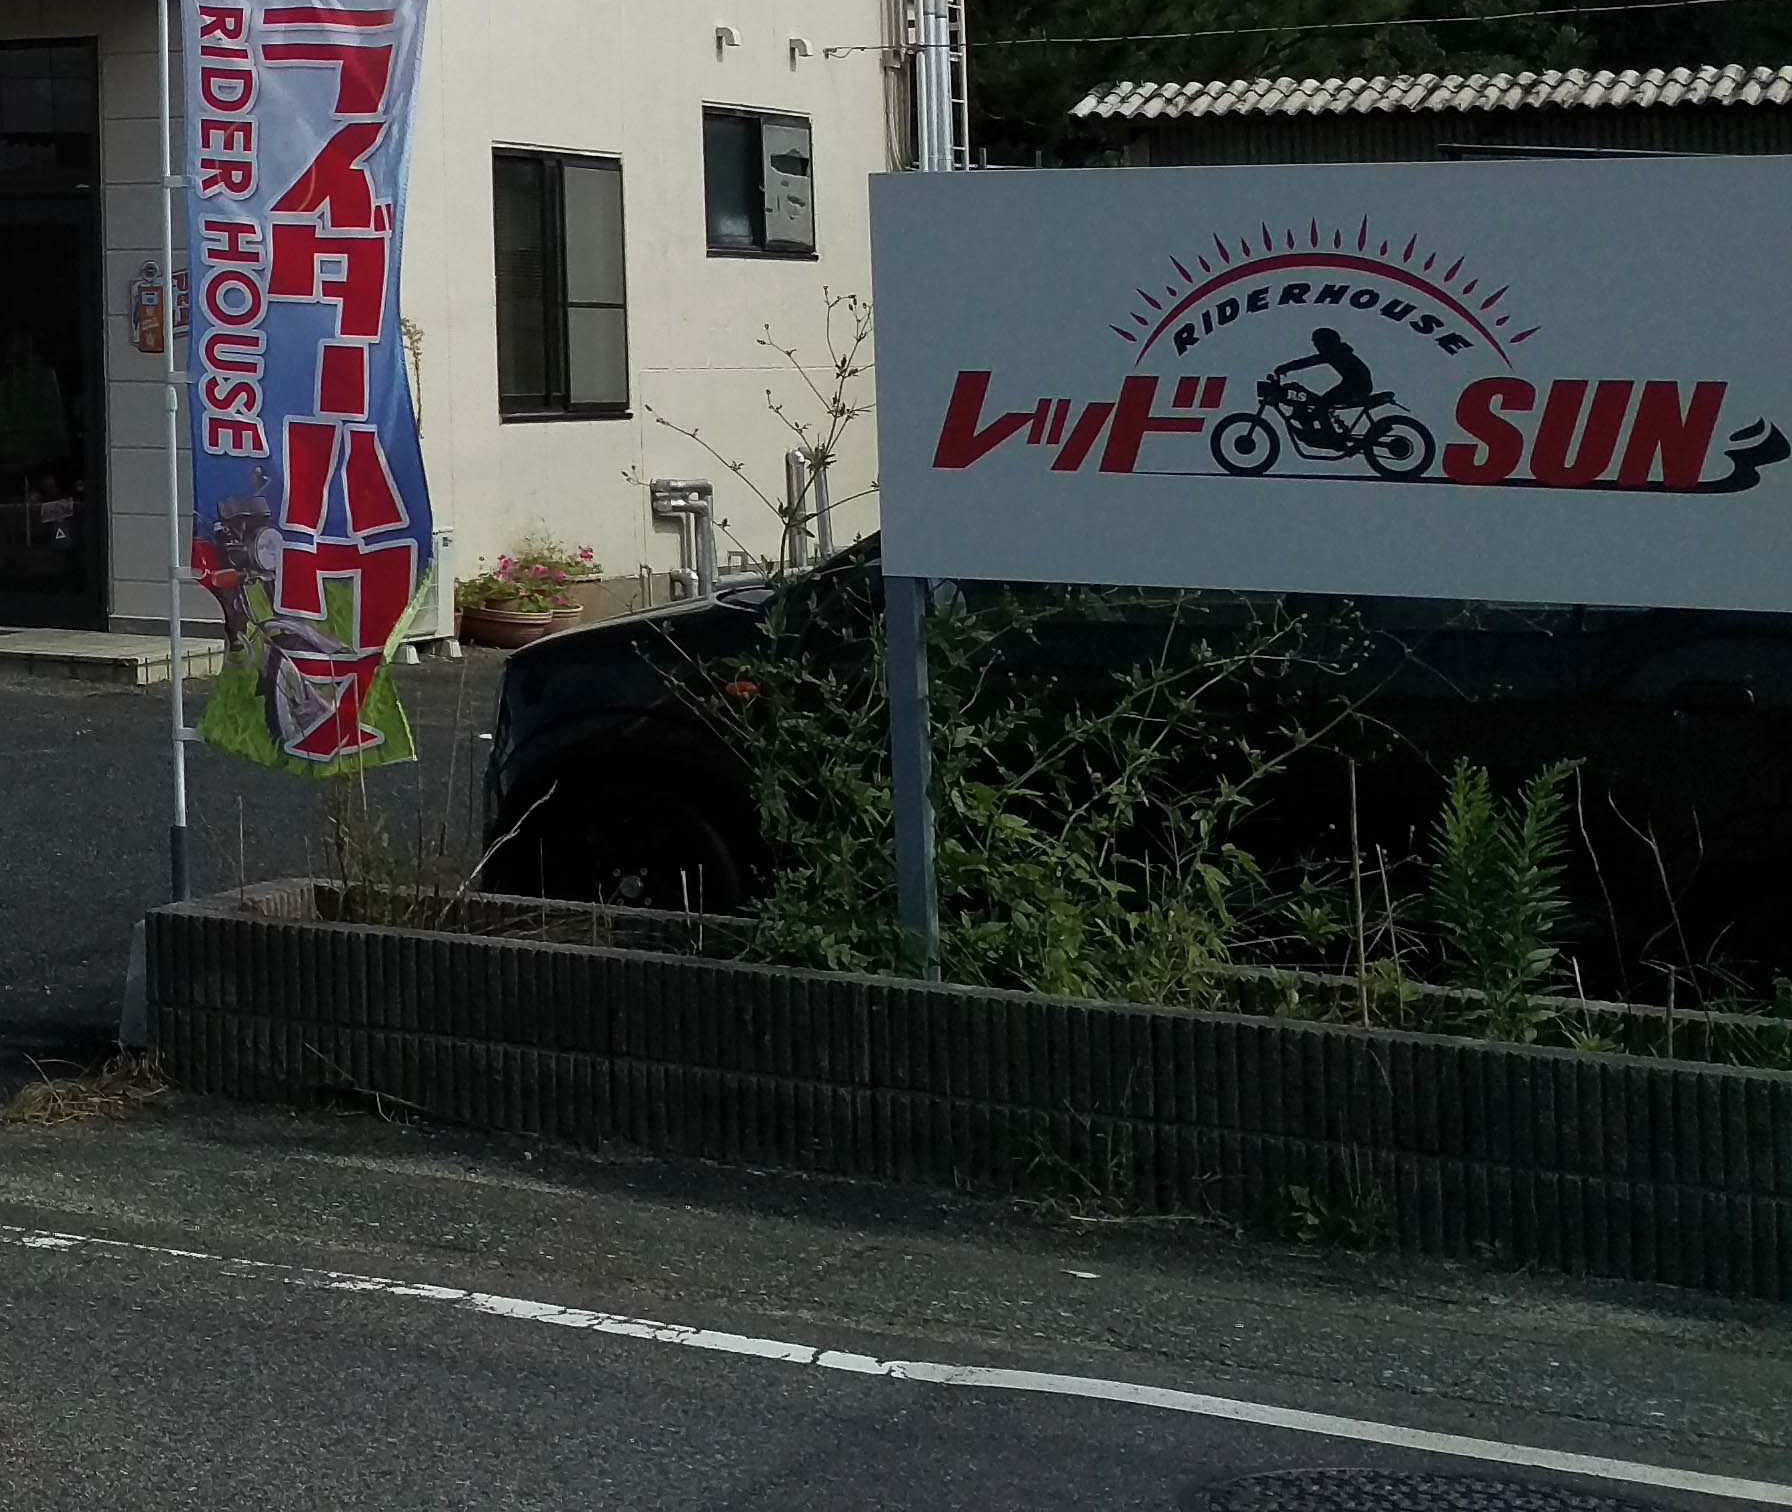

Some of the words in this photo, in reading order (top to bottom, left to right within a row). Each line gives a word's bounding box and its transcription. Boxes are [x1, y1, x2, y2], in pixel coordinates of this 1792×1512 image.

[199, 5, 258, 202] RIDER
[200, 219, 268, 458] HOUSE
[1173, 282, 1473, 358] RIDERHOUSE
[932, 370, 1226, 473] レッド
[1442, 376, 1727, 488] SUN
